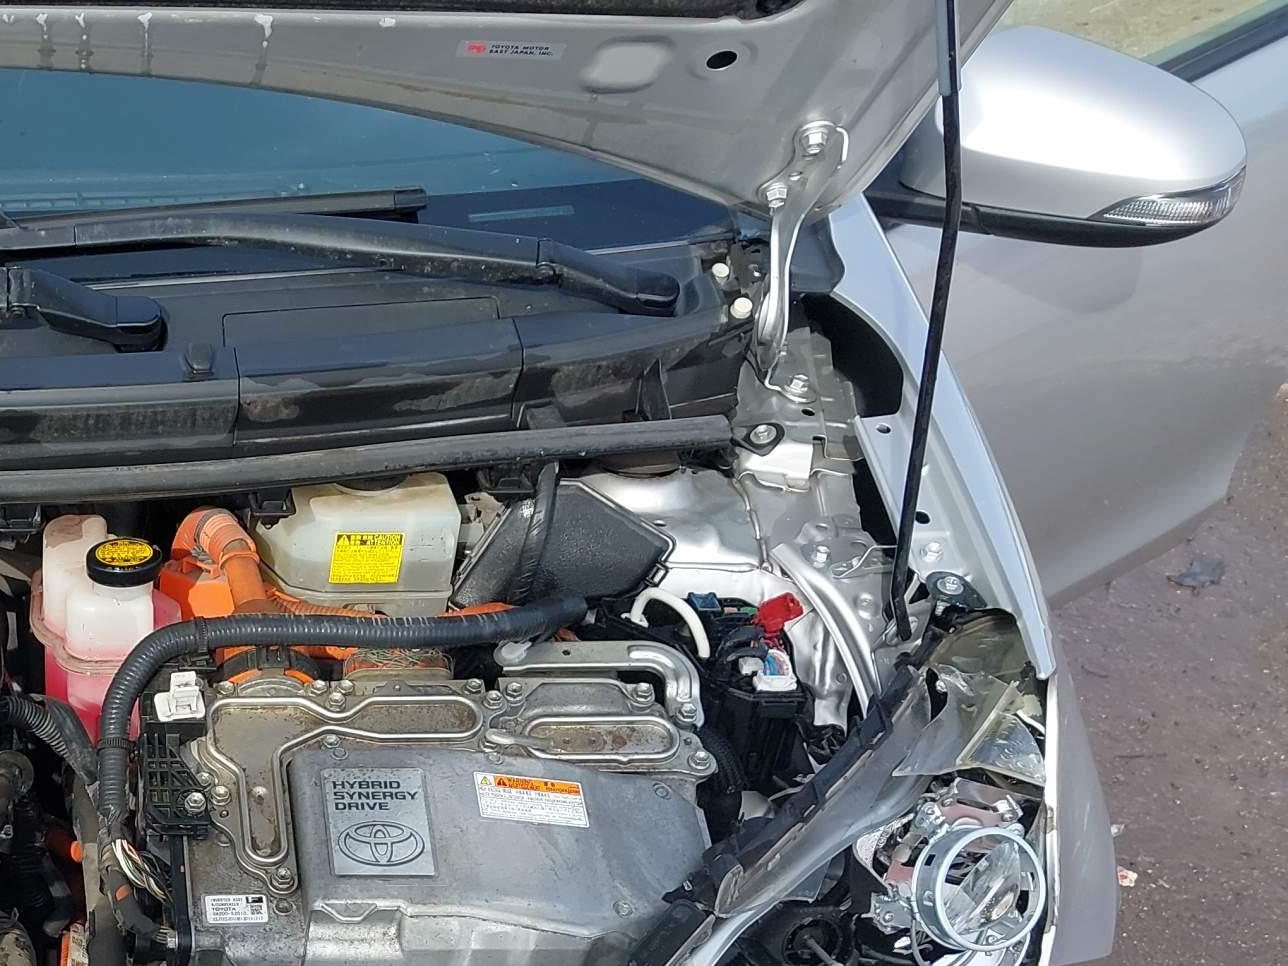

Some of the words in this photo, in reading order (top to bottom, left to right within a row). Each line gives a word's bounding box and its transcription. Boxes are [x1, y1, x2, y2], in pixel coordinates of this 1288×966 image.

[332, 780, 401, 790] HYBRID
[333, 791, 419, 801] SYNERGY
[335, 801, 391, 811] DRIVE
